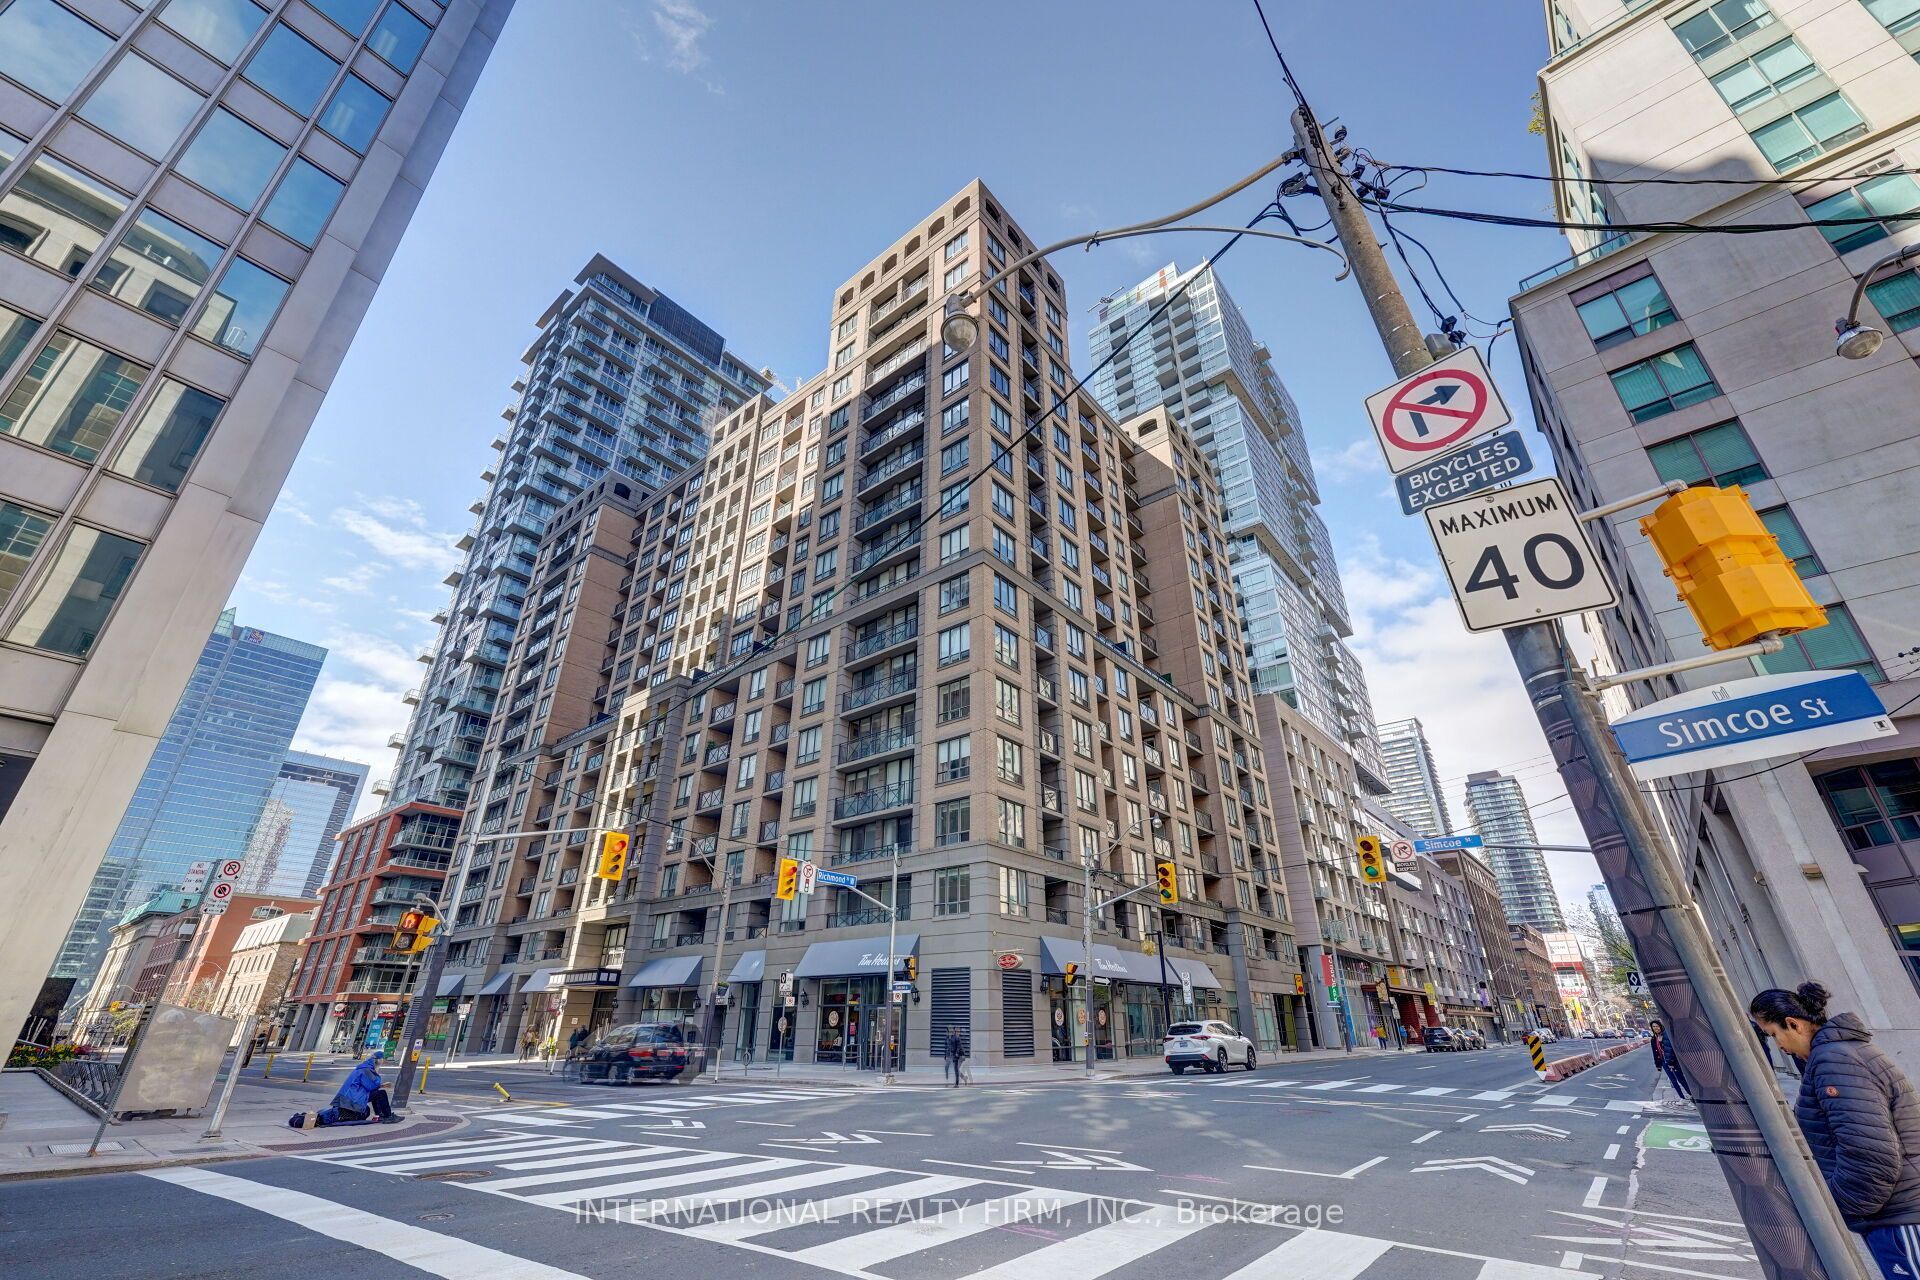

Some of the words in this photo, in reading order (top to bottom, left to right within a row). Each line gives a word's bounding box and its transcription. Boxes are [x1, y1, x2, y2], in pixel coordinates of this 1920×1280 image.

[1408, 441, 1509, 489] BICYCLES
[1408, 456, 1521, 508] EXCEPTED
[1438, 493, 1558, 536] MAXIMUM
[1464, 532, 1585, 600] 40
[1658, 703, 1794, 748] Simcoe
[1800, 698, 1834, 719] St
[1424, 839, 1462, 850] Simcoe
[818, 871, 846, 884] Richmond
[858, 953, 872, 967] Tim
